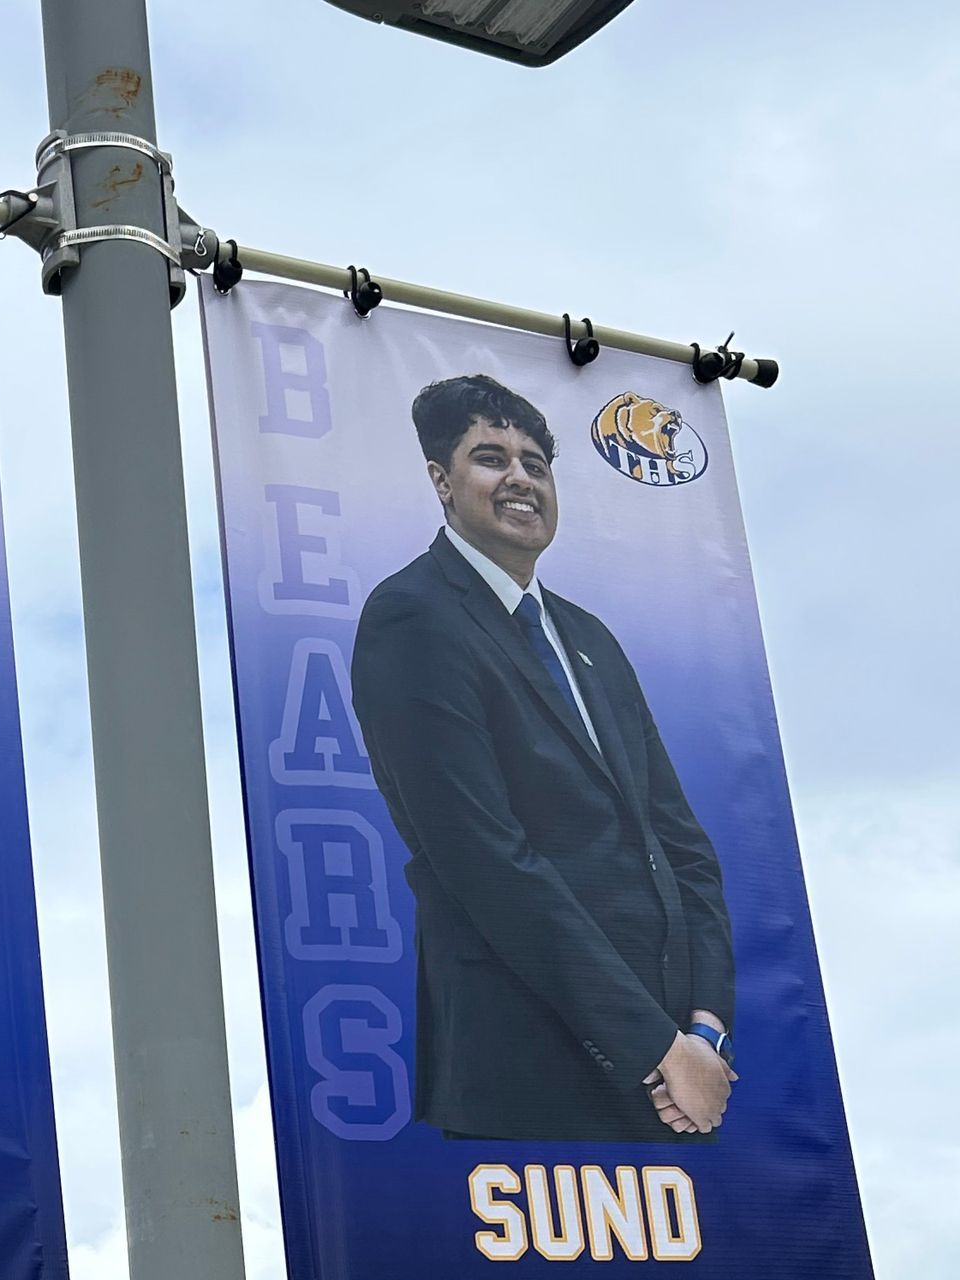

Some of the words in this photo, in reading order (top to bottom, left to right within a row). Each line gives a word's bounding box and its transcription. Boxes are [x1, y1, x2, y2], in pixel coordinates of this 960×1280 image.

[608, 439, 696, 485] THS
[251, 320, 412, 1141] BEARS
[467, 1163, 702, 1262] SUND
